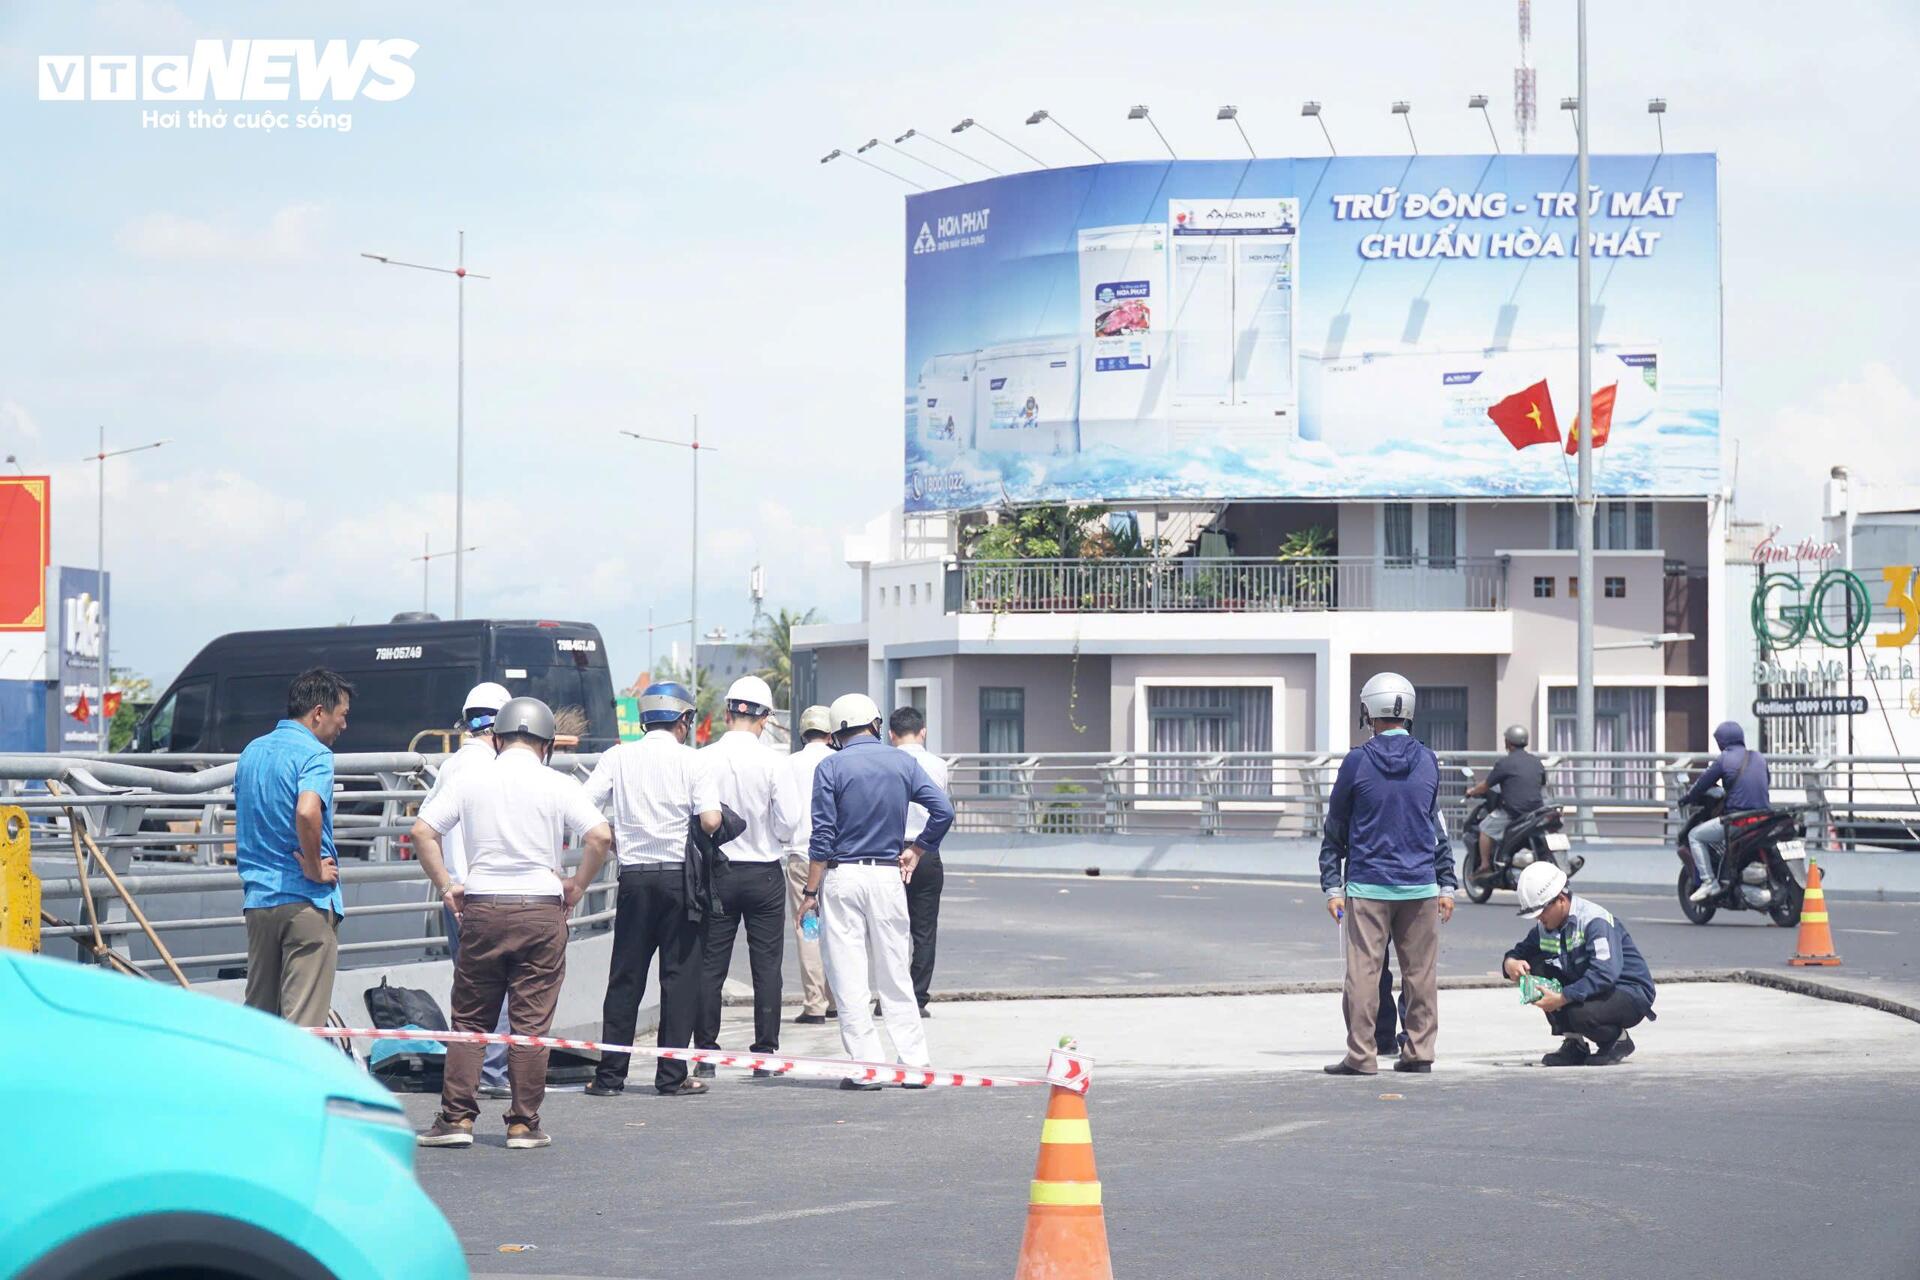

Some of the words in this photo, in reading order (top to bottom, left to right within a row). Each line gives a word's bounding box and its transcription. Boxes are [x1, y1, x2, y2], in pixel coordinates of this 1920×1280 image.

[1333, 186, 1400, 219] TRỮ
[1404, 187, 1508, 218] ĐÔNG
[1610, 186, 1684, 217] MÁT
[937, 215, 961, 239] HOA
[961, 208, 991, 234] PHAT
[1360, 224, 1481, 259] CHUẨN
[1489, 226, 1566, 257] HÒA
[1876, 565, 1920, 648] 3
[1756, 701, 1794, 715] Hotline:
